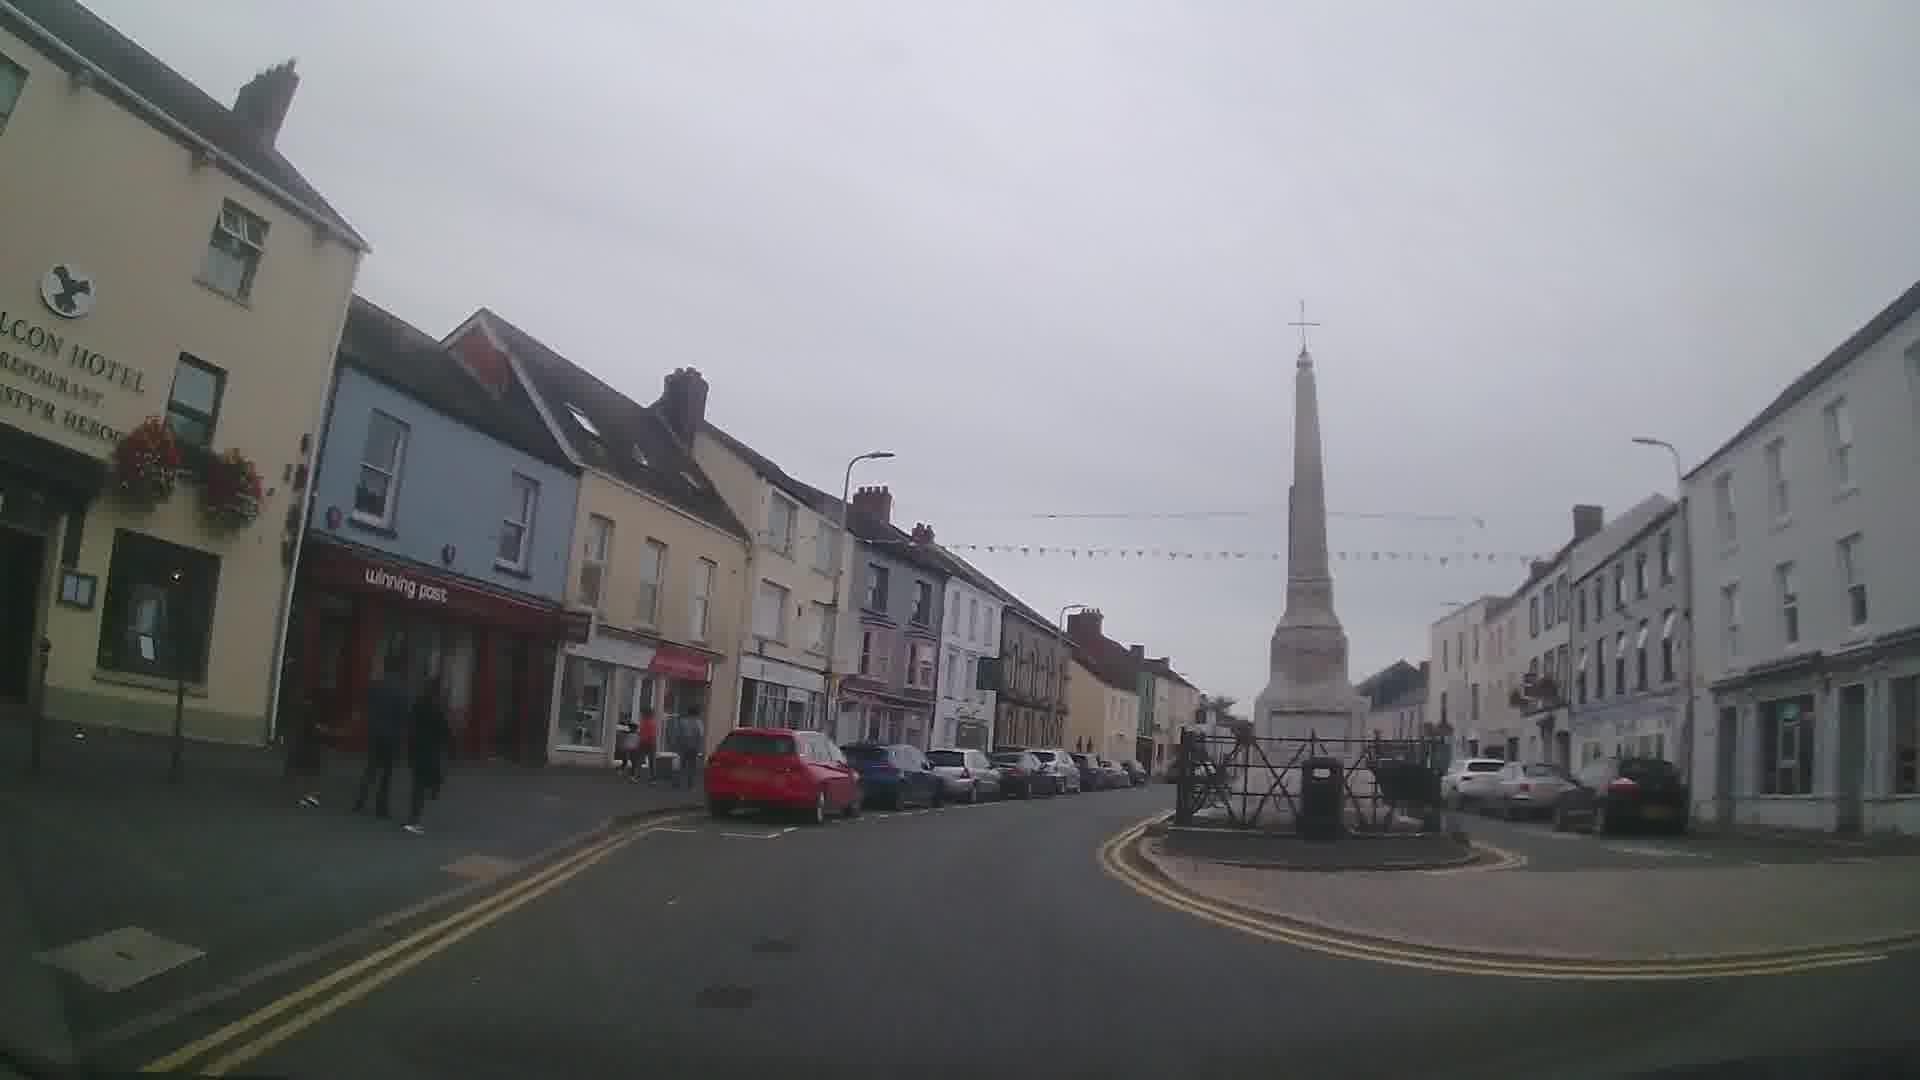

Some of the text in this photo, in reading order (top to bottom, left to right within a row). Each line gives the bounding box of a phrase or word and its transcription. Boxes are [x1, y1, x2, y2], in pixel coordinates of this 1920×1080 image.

[72, 344, 145, 393] HOTEL
[365, 567, 449, 603] winning post
